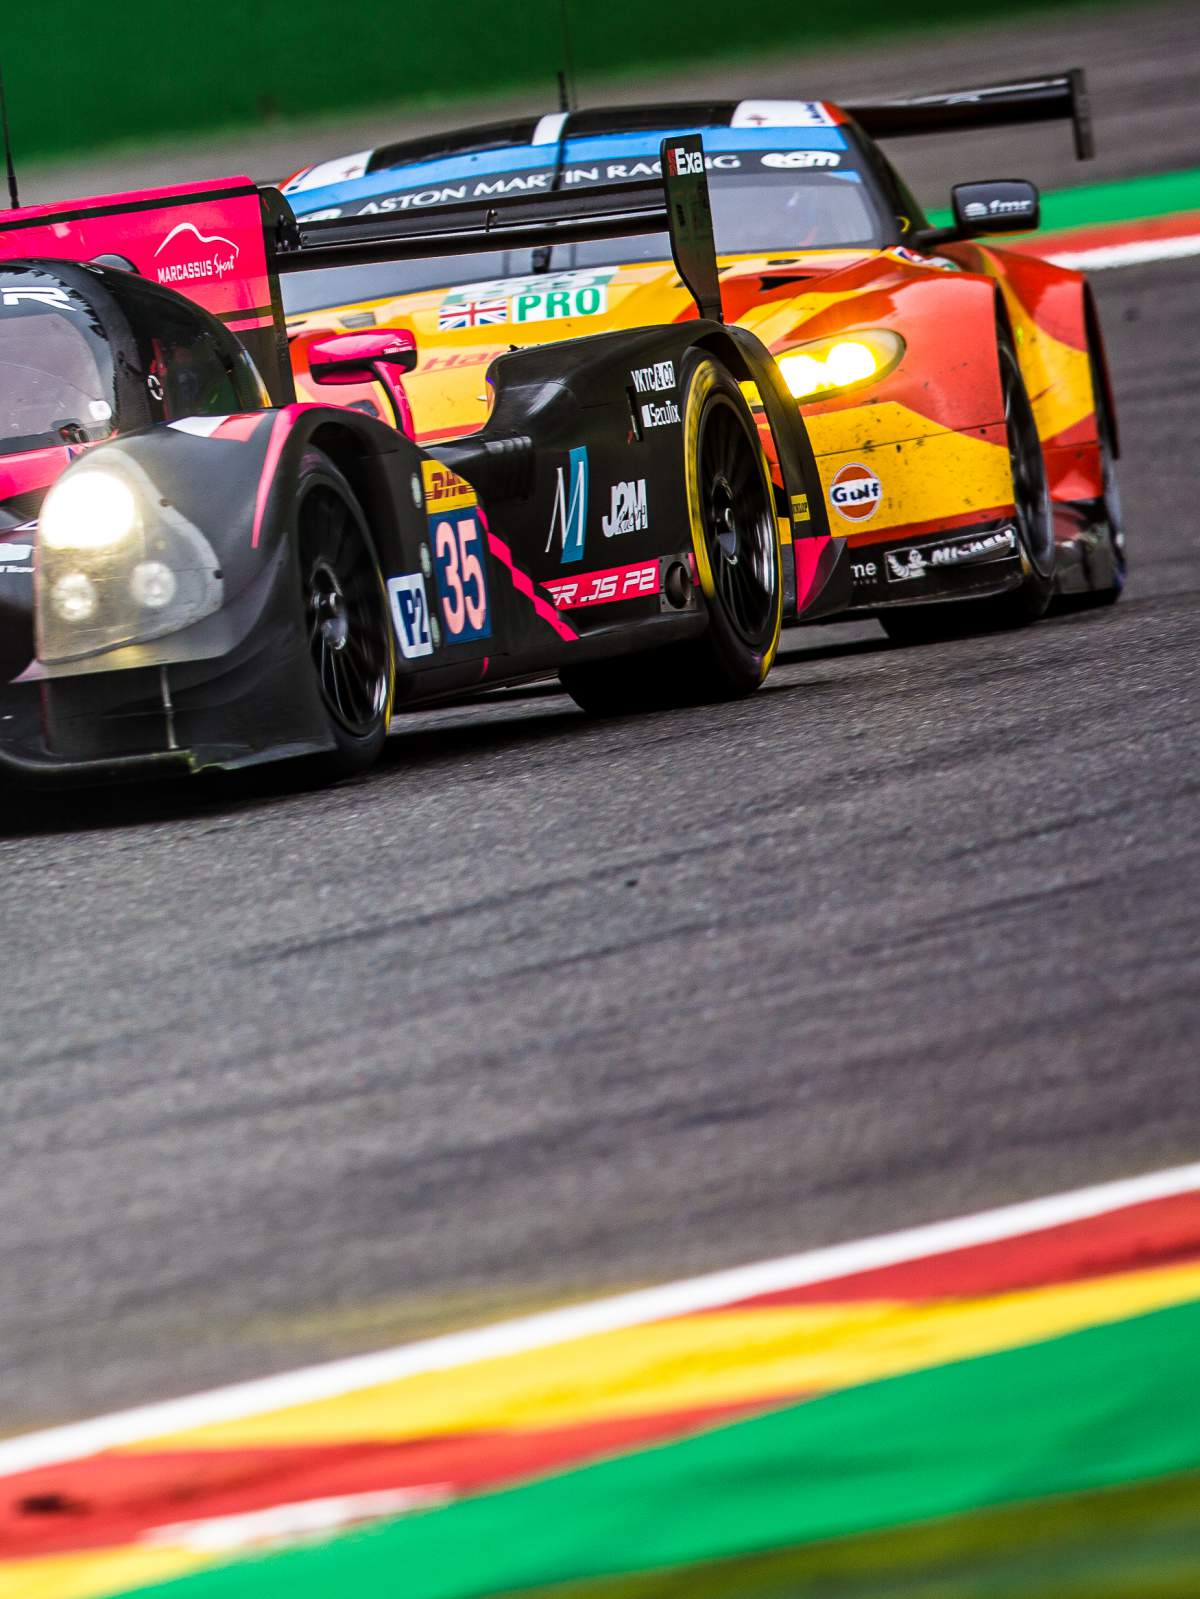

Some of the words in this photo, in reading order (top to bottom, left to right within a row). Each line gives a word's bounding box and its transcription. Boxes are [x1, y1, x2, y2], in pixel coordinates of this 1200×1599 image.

[356, 185, 467, 216] ASTON
[607, 154, 741, 179] RACG
[157, 260, 212, 284] MARCASSUS
[213, 253, 234, 279] Sport
[518, 288, 601, 322] PRO
[602, 479, 648, 538] J2M
[831, 482, 880, 503] Gulf
[436, 519, 486, 635] 35
[580, 575, 619, 602] JS
[622, 567, 656, 594] P2
[397, 588, 429, 646] P2
